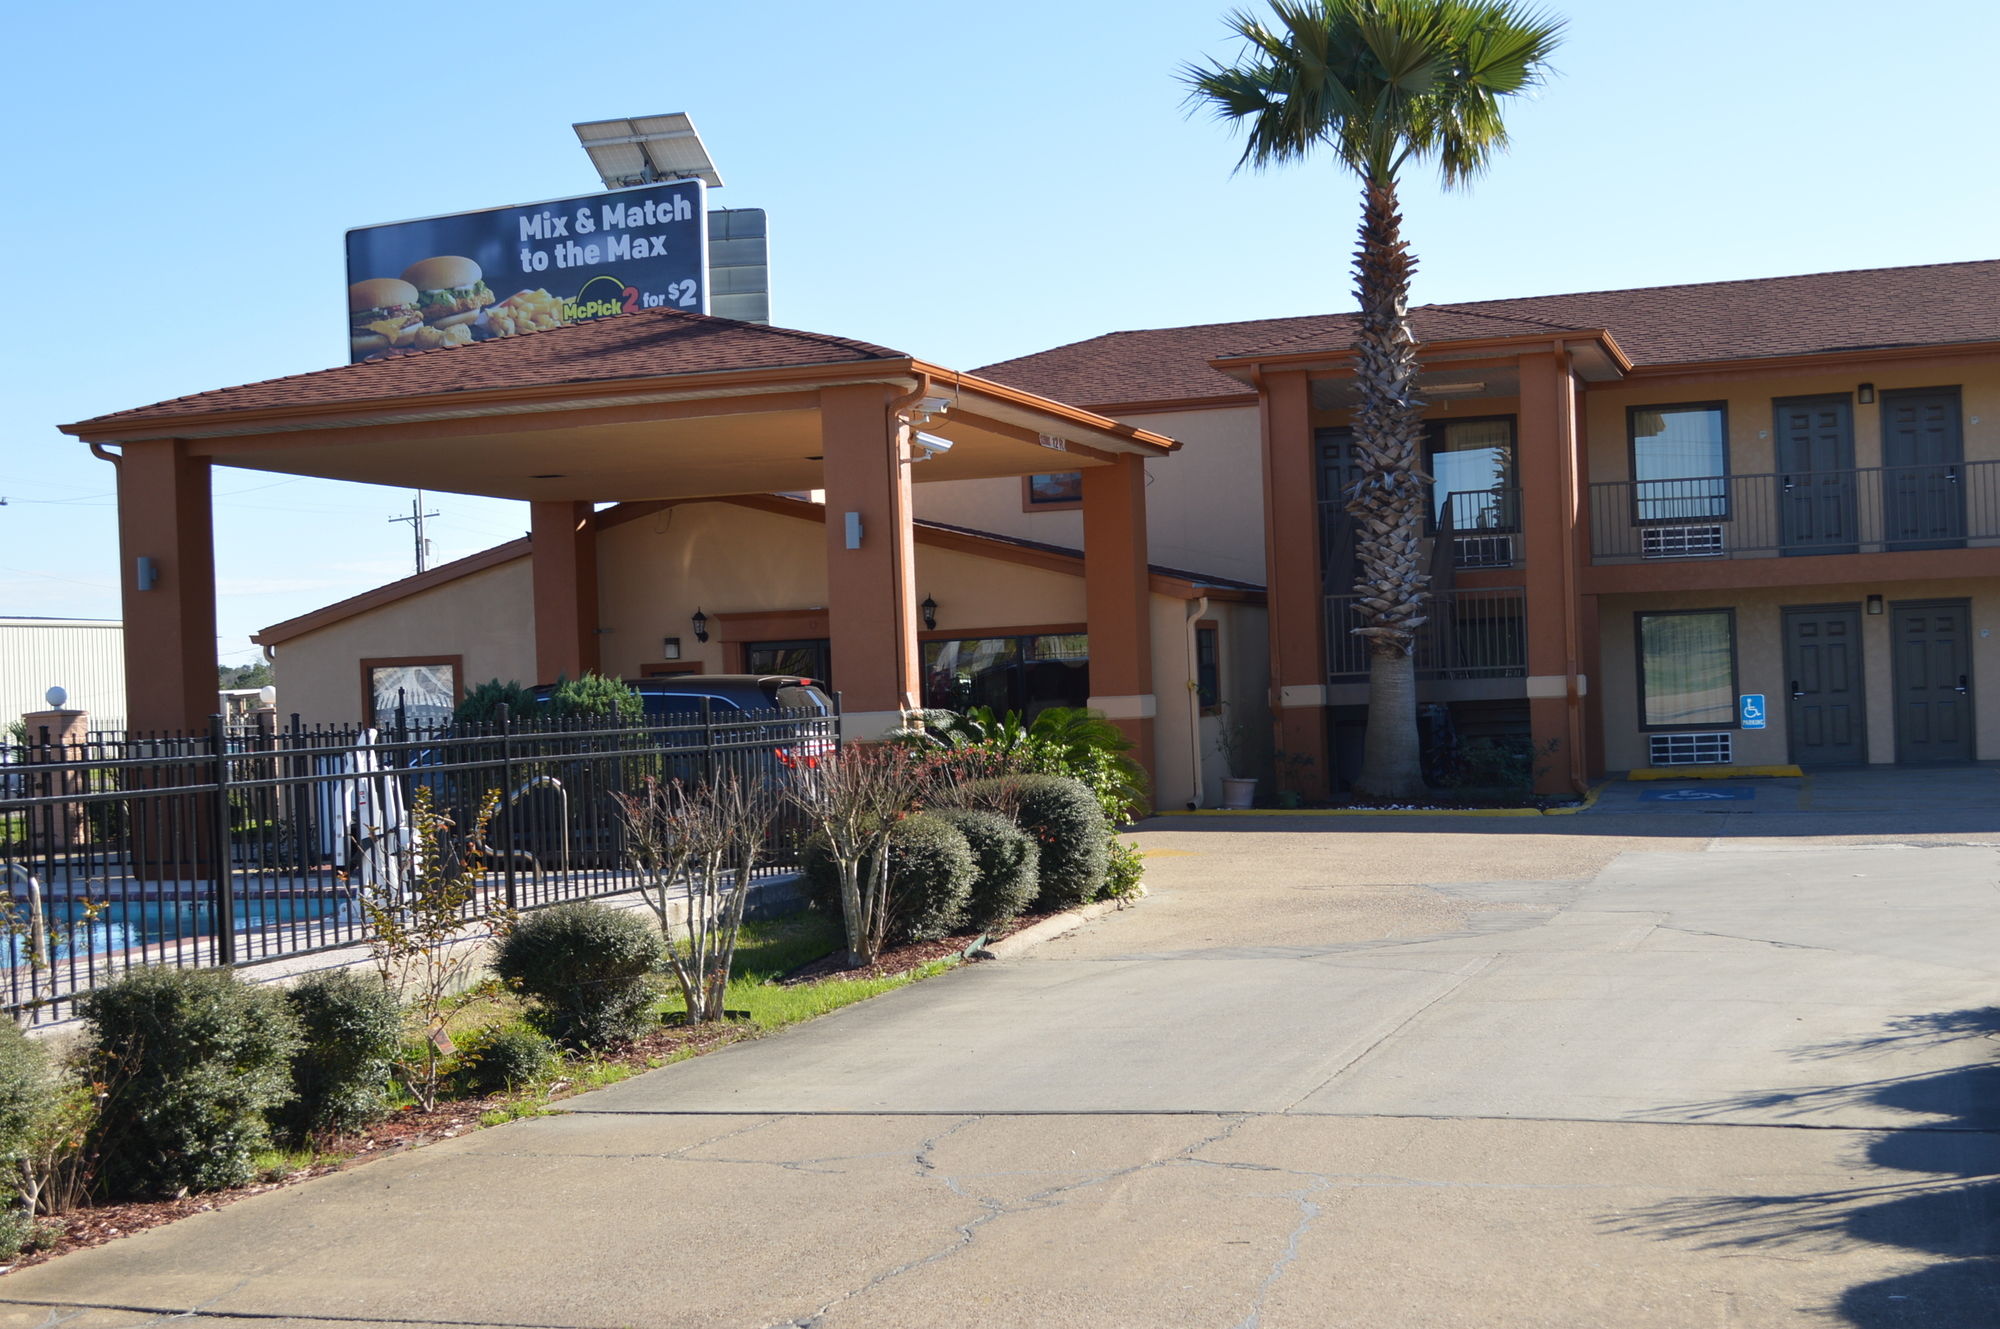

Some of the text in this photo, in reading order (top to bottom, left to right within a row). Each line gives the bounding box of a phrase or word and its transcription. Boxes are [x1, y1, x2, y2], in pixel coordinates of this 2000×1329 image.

[519, 194, 692, 241] Mix & Match
[520, 234, 668, 273] to the Max
[563, 279, 697, 320] McPick 2 for $2
